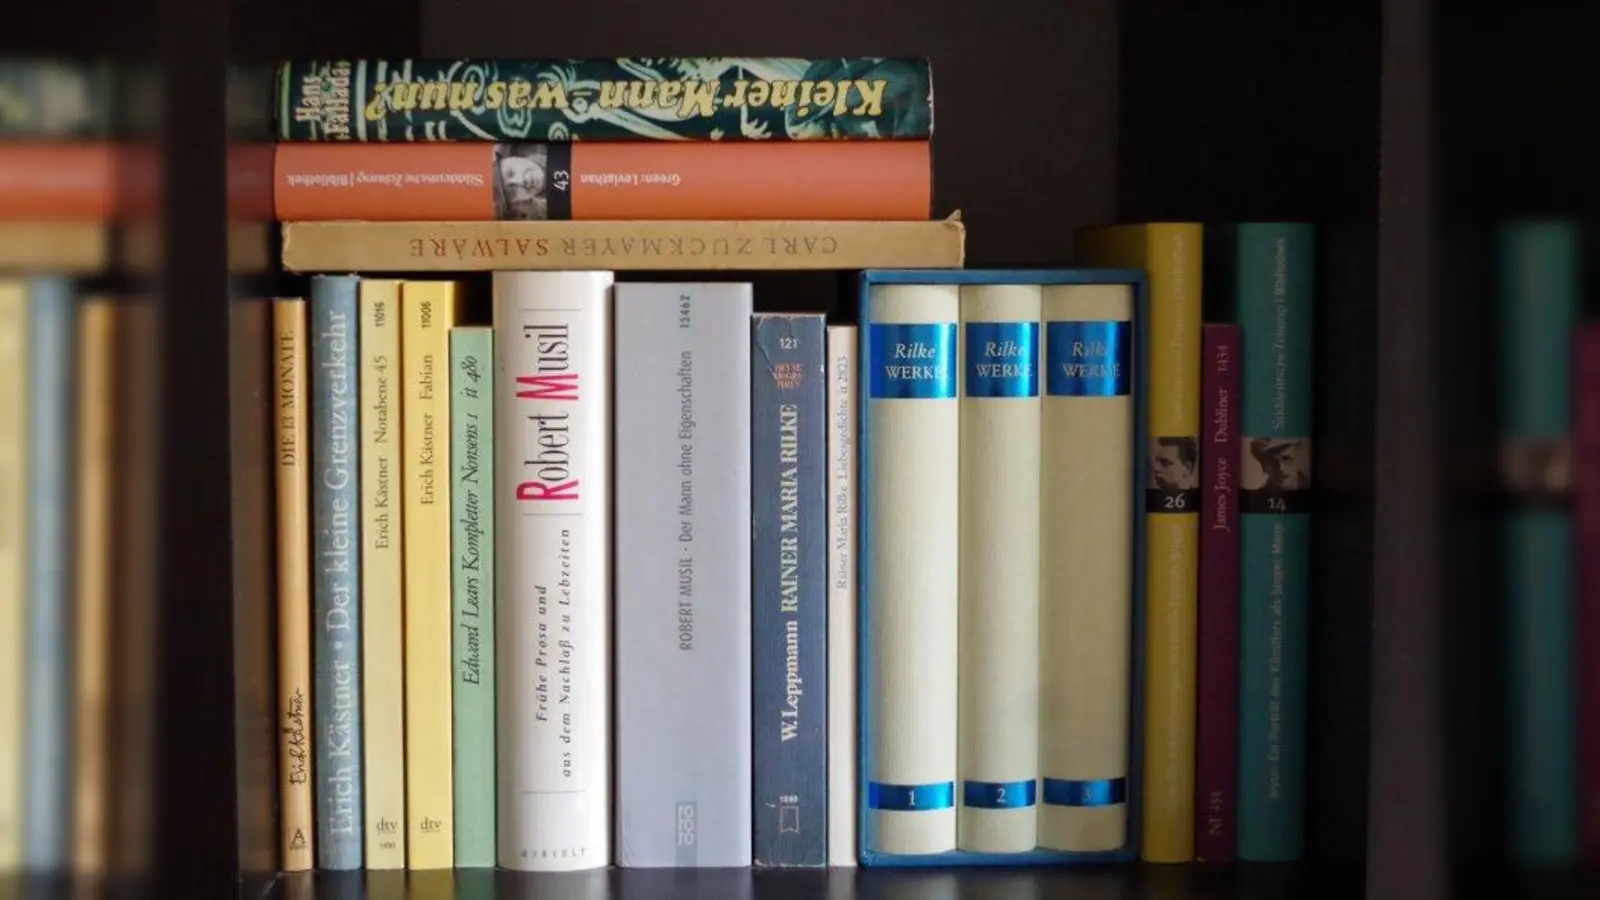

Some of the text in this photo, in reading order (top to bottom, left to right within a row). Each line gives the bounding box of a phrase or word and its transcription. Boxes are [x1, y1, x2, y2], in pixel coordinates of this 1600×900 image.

[365, 79, 887, 121] Kleiner Mann was nun?
[286, 171, 349, 187] Bibliothek
[357, 171, 402, 188] Zeitung
[552, 170, 570, 191] 43
[580, 172, 682, 187] Green: Leviathan
[561, 236, 752, 256] ZUCKMAYER
[763, 235, 838, 254] CARL
[374, 301, 385, 328] 11016
[780, 336, 798, 350] 121
[894, 343, 936, 359] Rilke
[460, 355, 482, 384] 480
[836, 356, 848, 383] 2823
[279, 330, 296, 467] DIE 13 MONATE
[515, 323, 580, 500] Robert Musil
[1214, 387, 1229, 443] Dubliner
[419, 354, 434, 505] Erich Kästner Fabian
[780, 404, 798, 463] RILKE
[837, 398, 851, 479] Liebesgedichte
[373, 355, 389, 550] Erich Kästner Notabene 45
[460, 423, 479, 484] Nonsens
[1214, 457, 1231, 491] Joyce
[676, 350, 697, 652] ROBERT MUSIL Der Mann ohne Eigenschaften
[780, 465, 799, 532] MARIA
[836, 485, 849, 515] Rilke
[1164, 494, 1186, 509] 26
[1214, 494, 1230, 532] James
[1268, 497, 1287, 511] 14
[460, 490, 484, 571] Kompletter
[836, 516, 849, 550] Maria
[321, 309, 352, 836] Erich Kästner Der kleine Grenzverkehr
[780, 537, 799, 613] RAINER
[836, 552, 849, 590] Rainer
[461, 577, 480, 618] Lears
[461, 624, 480, 686] Edward
[534, 584, 548, 722] Frühe Prosa und
[558, 528, 575, 778] aus dem Nachlaß zu Lebzeiten
[908, 790, 916, 806] 1
[996, 788, 1006, 803] 2
[376, 817, 398, 831] dtv
[420, 815, 442, 831] dtv
